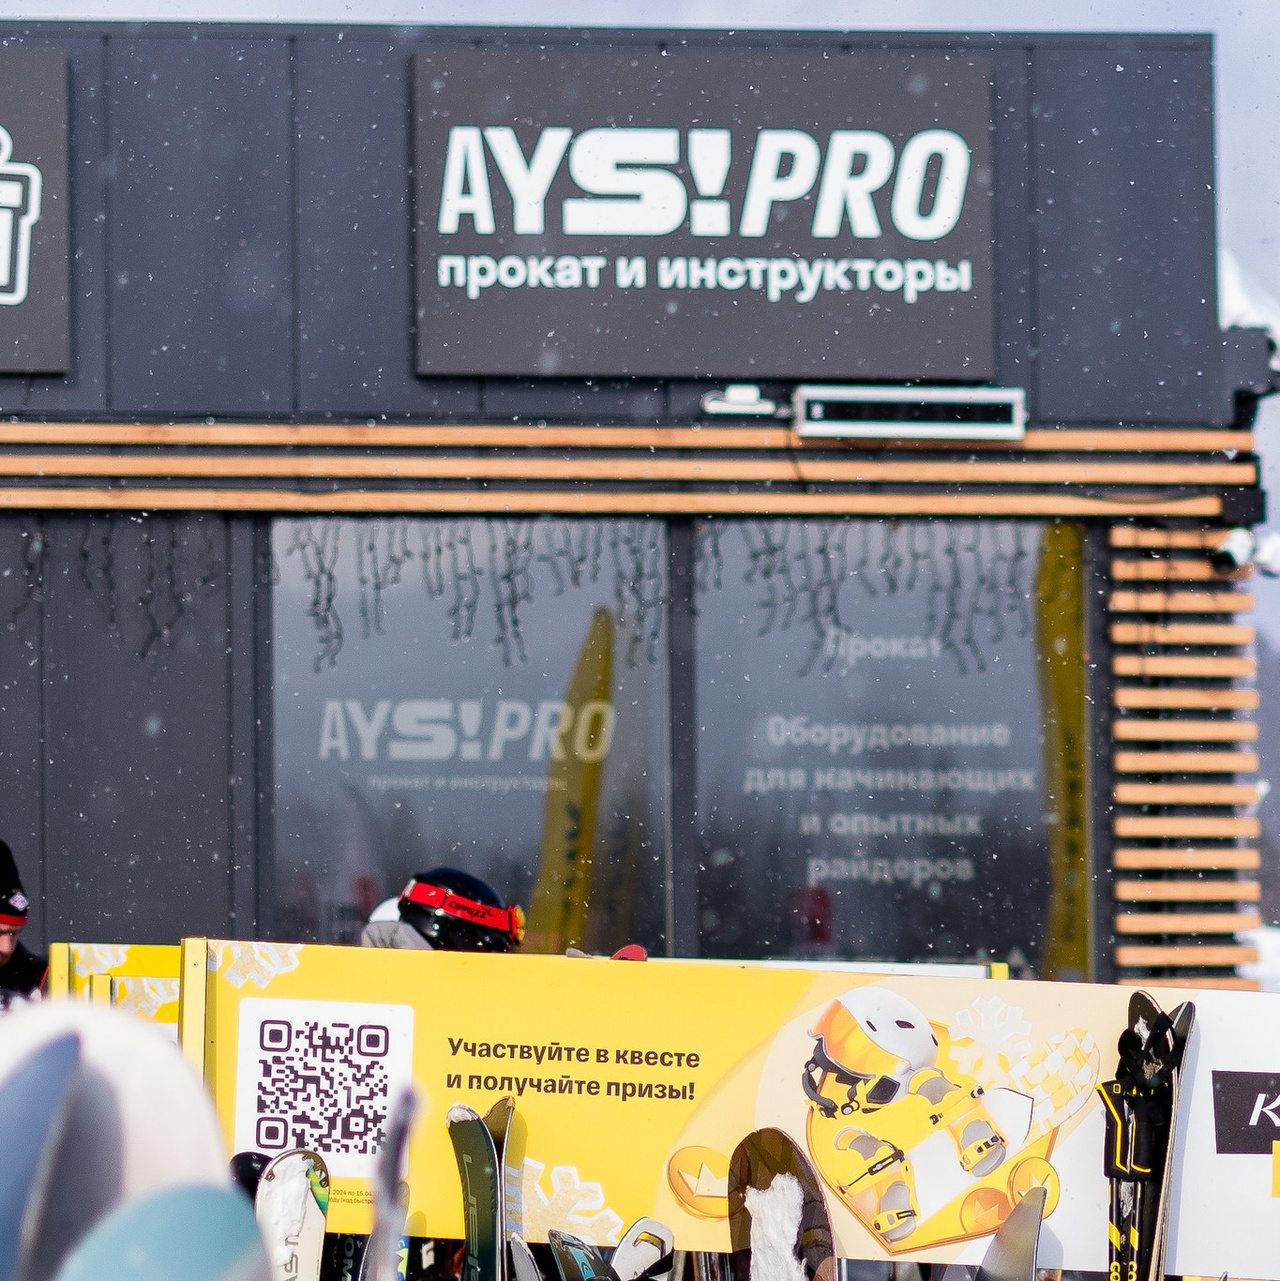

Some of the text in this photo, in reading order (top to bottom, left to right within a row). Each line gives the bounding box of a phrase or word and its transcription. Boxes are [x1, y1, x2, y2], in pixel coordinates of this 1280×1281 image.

[437, 255, 972, 303] прокат и инструкторы
[447, 1037, 700, 1068] Участвуйте в квесте
[446, 1073, 696, 1101] и получайте призы!
